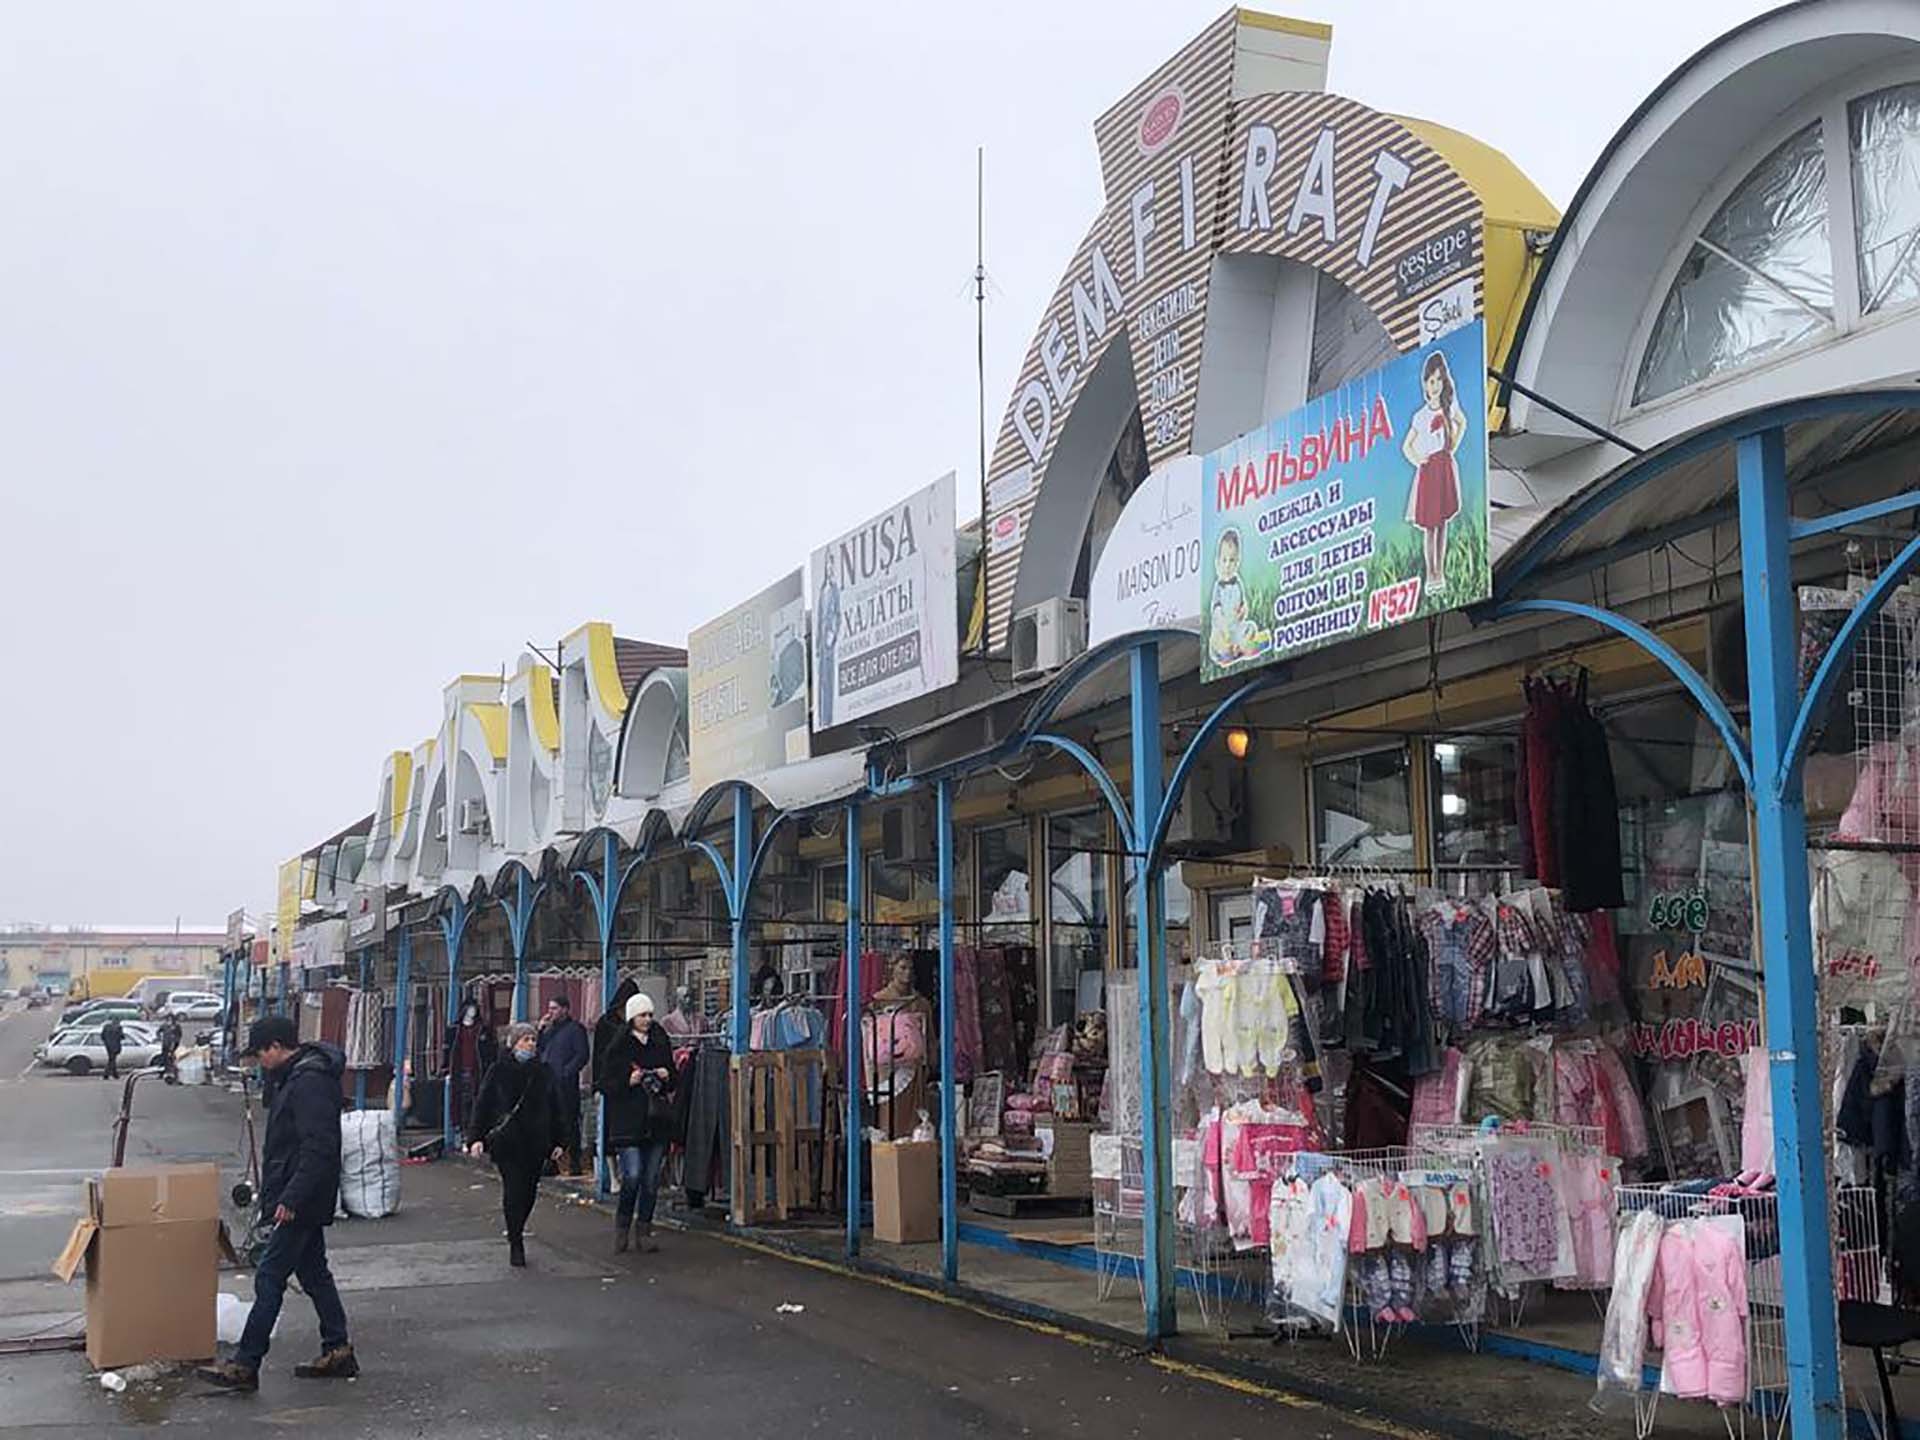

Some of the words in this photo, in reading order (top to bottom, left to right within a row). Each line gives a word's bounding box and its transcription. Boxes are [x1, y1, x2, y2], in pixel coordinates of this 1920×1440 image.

[1216, 395, 1393, 512] МАЛЬВИНА
[1258, 491, 1322, 532] ОДЕЖДА
[1270, 501, 1373, 559] АКСЕССУАРЫ
[1117, 550, 1171, 602] MAISON
[1281, 556, 1314, 585] ДЛЯ
[1320, 530, 1373, 571] ДЕТЕЙ
[843, 579, 913, 641] ХАЛАТЫ
[1276, 584, 1329, 616] ОПТОМ
[1354, 571, 1366, 591] В
